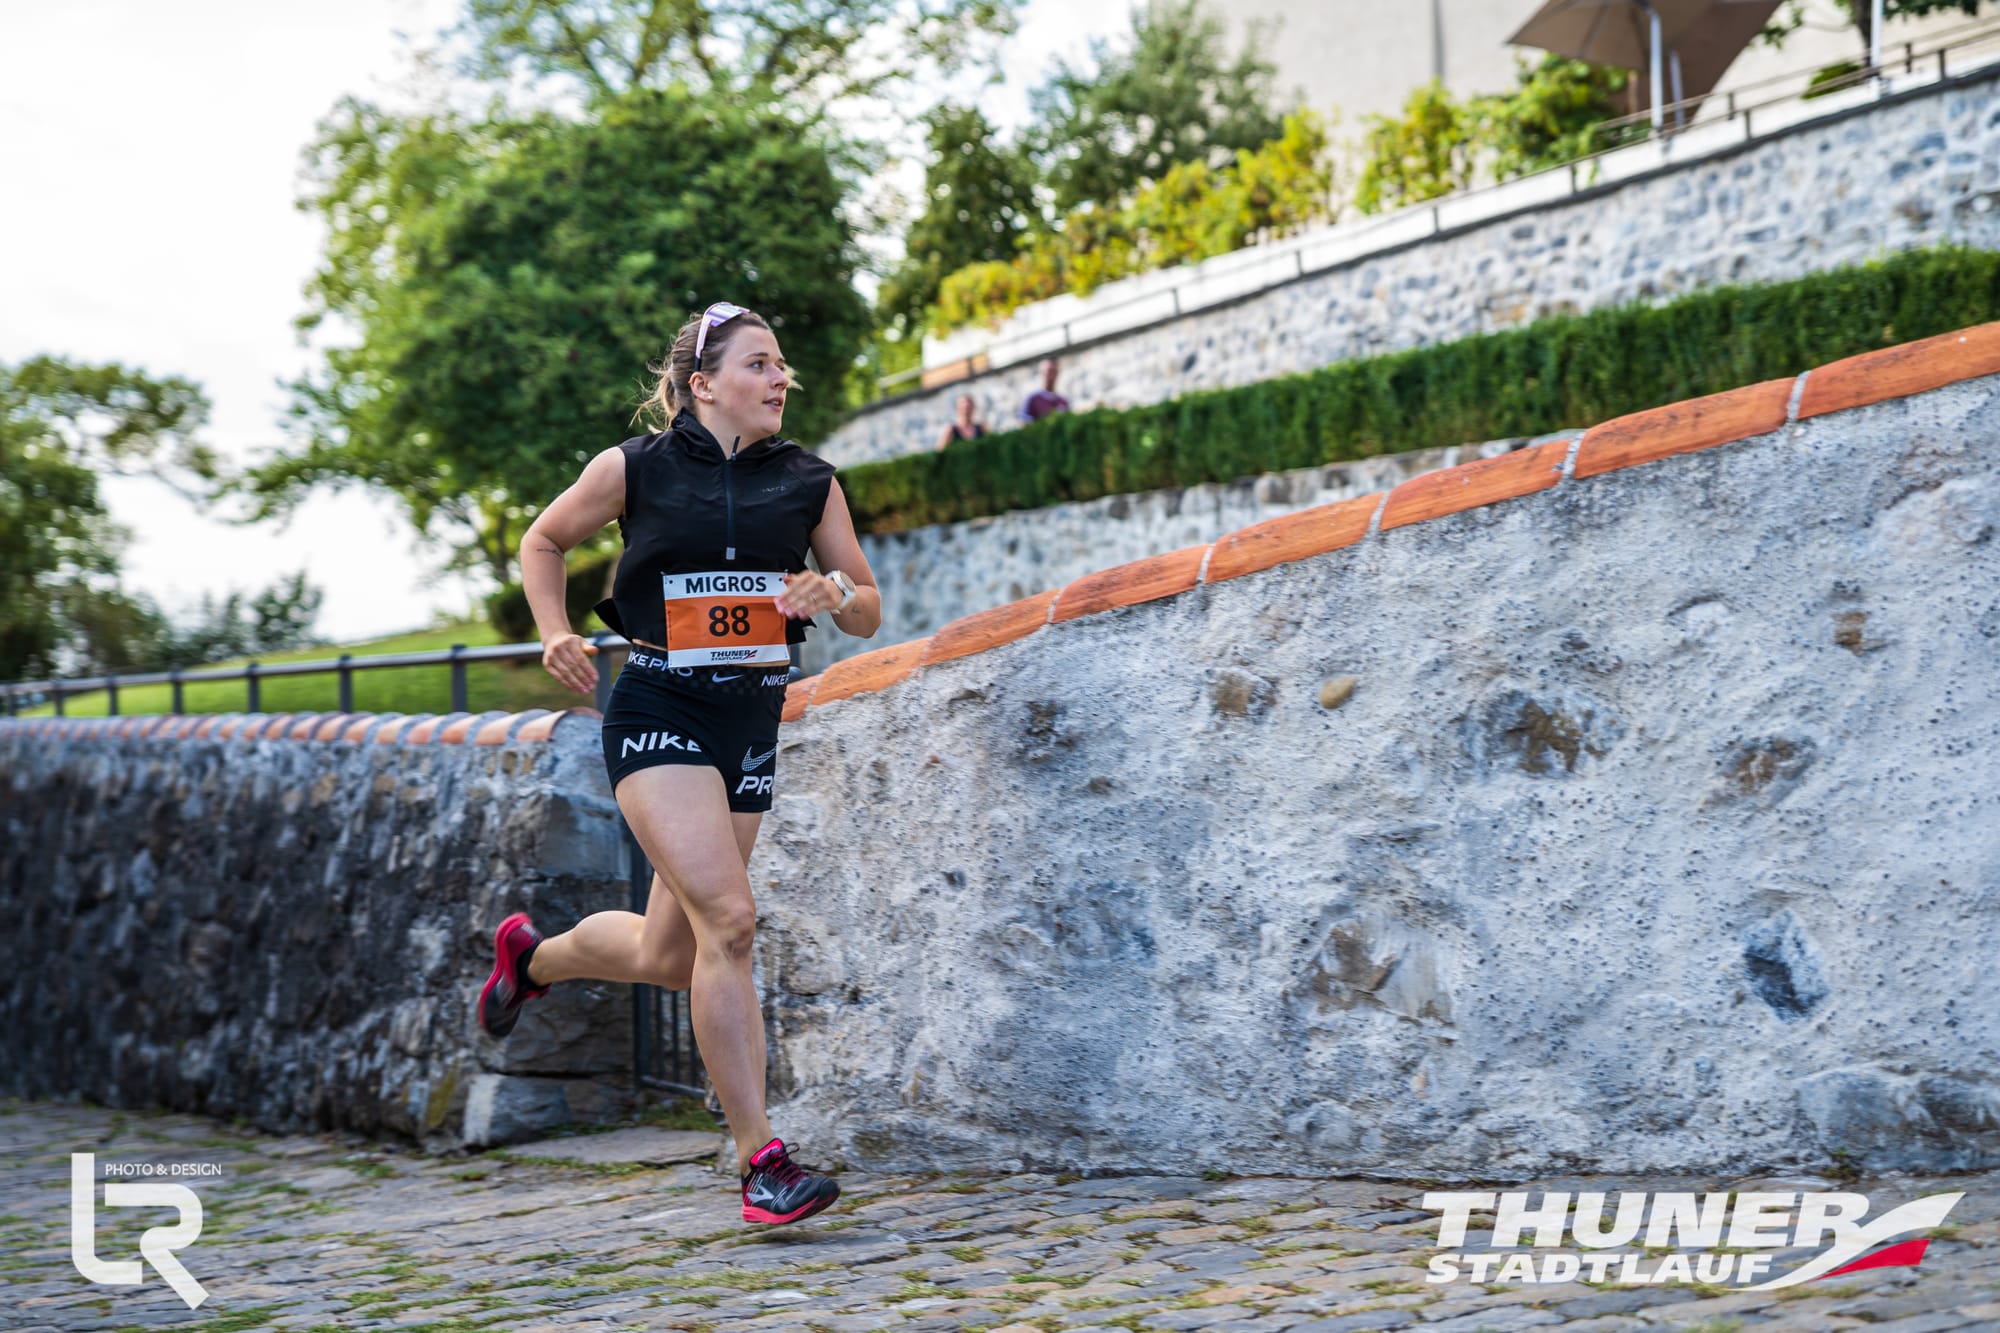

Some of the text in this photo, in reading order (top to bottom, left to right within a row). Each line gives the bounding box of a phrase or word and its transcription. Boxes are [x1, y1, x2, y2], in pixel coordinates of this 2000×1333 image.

[685, 575, 767, 594] MIGROS
[708, 605, 751, 637] 88
[628, 651, 649, 666] IKE
[710, 649, 751, 657] THUNER
[761, 673, 786, 687] NIKE
[735, 775, 773, 795] PR
